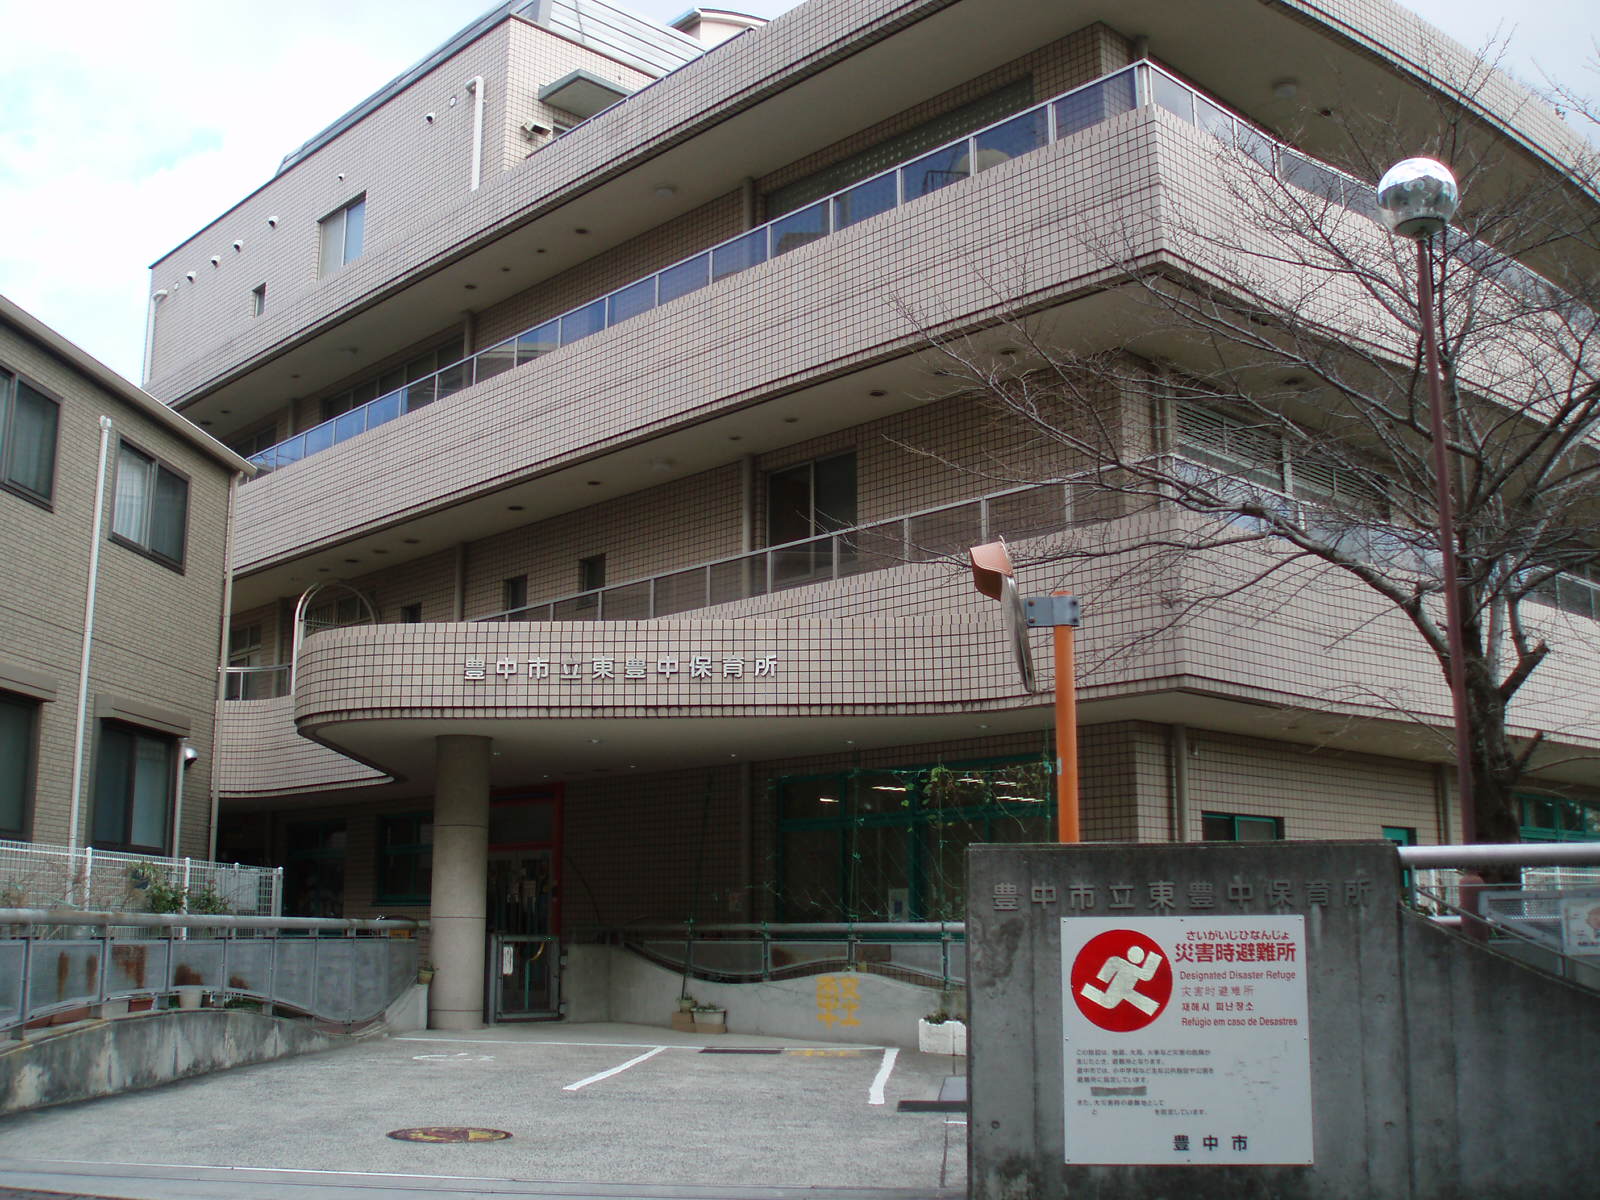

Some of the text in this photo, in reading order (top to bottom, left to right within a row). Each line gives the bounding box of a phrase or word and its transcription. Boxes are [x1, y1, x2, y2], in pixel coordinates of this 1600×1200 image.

[463, 654, 777, 681] 豊中市立東豊中保育所
[991, 880, 1373, 912] 豊中市立東豊中保育所
[1186, 930, 1291, 941] さいがいじひなんじょ
[1174, 942, 1297, 963] 災害時避難所
[1180, 970, 1296, 982] Designated Disaster Refuge
[1181, 1002, 1254, 1012] 재해시 피난장소
[1213, 1018, 1226, 1026] em
[1227, 1018, 1246, 1026] caso
[1248, 1016, 1258, 1026] de
[1260, 1016, 1298, 1026] Desastres
[1173, 1134, 1248, 1151] 豊中市
